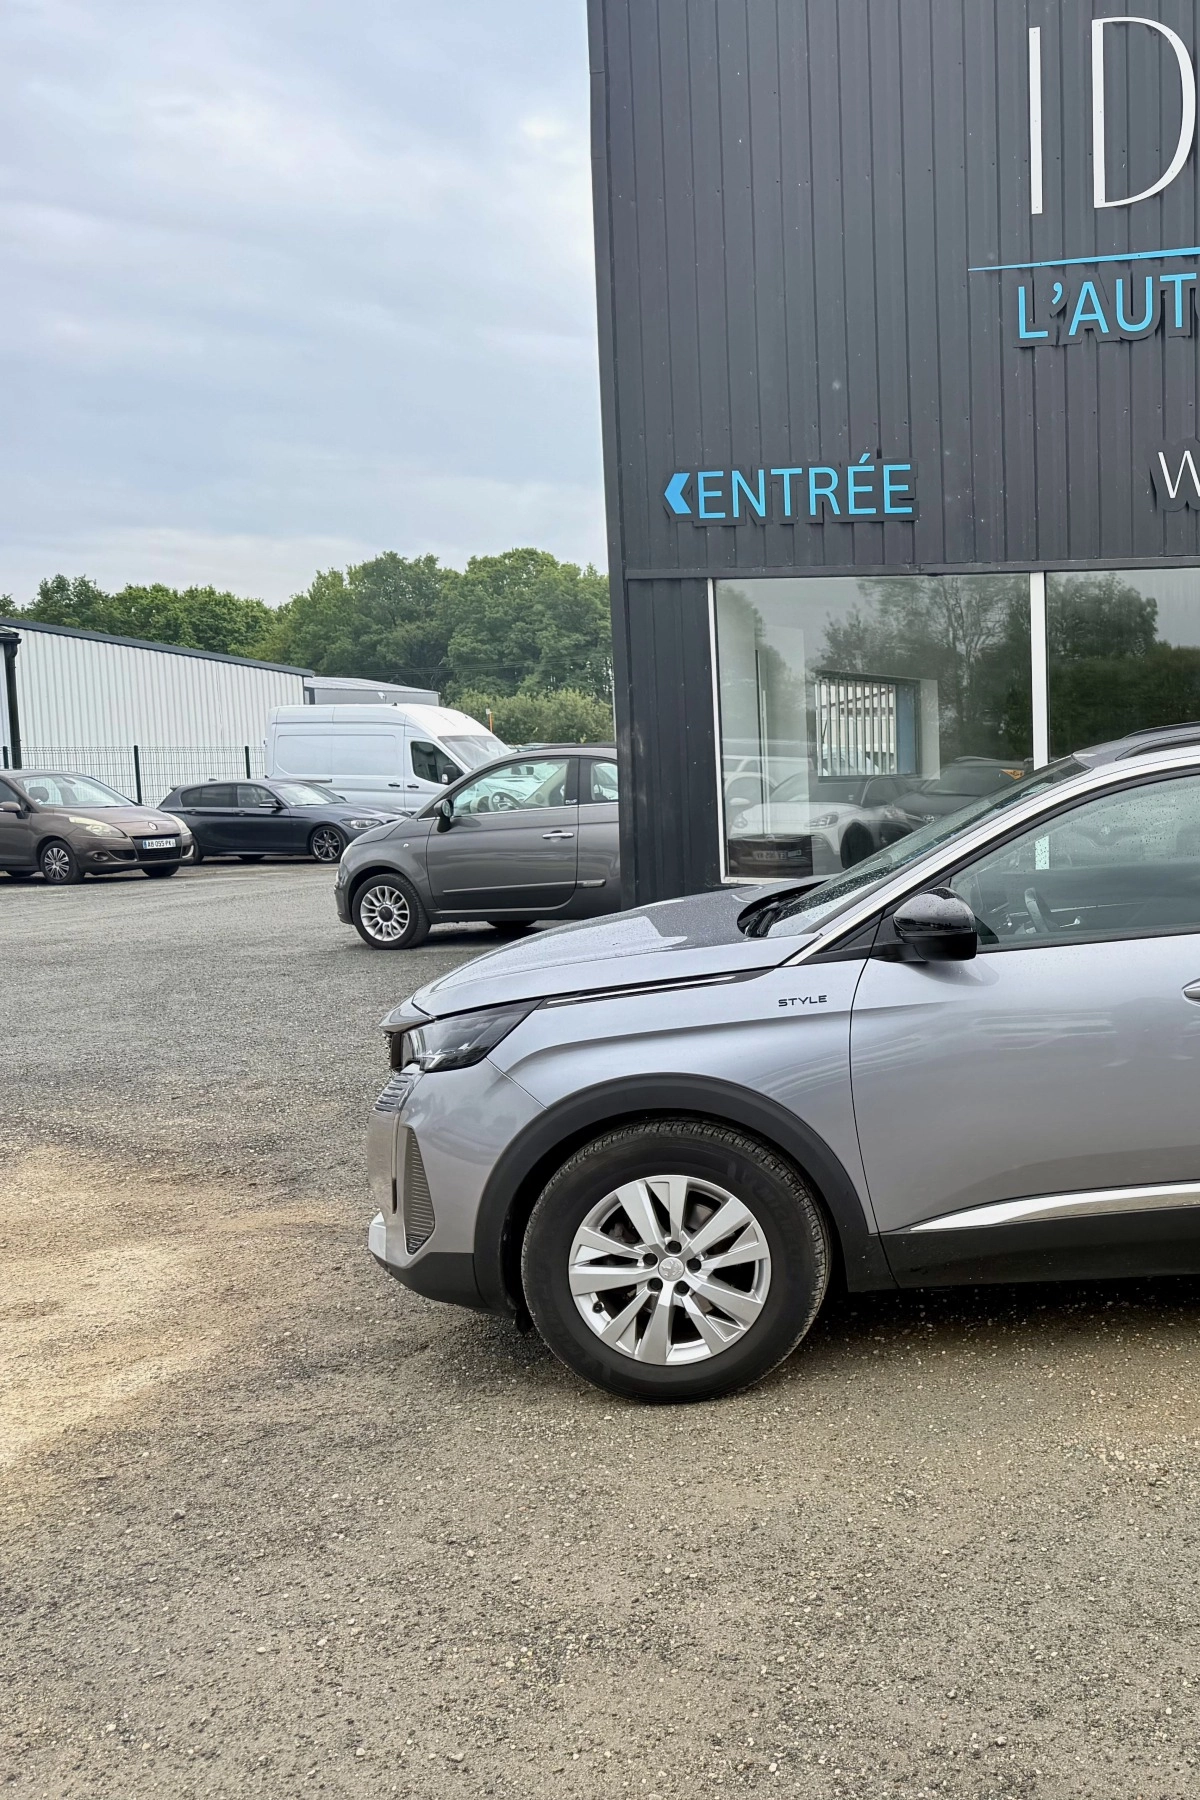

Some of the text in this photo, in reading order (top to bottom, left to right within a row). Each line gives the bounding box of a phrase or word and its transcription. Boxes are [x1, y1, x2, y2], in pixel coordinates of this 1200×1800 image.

[1028, 16, 1196, 215] ID
[697, 452, 914, 519] ENTRÉE
[778, 994, 828, 1007] STYLE
